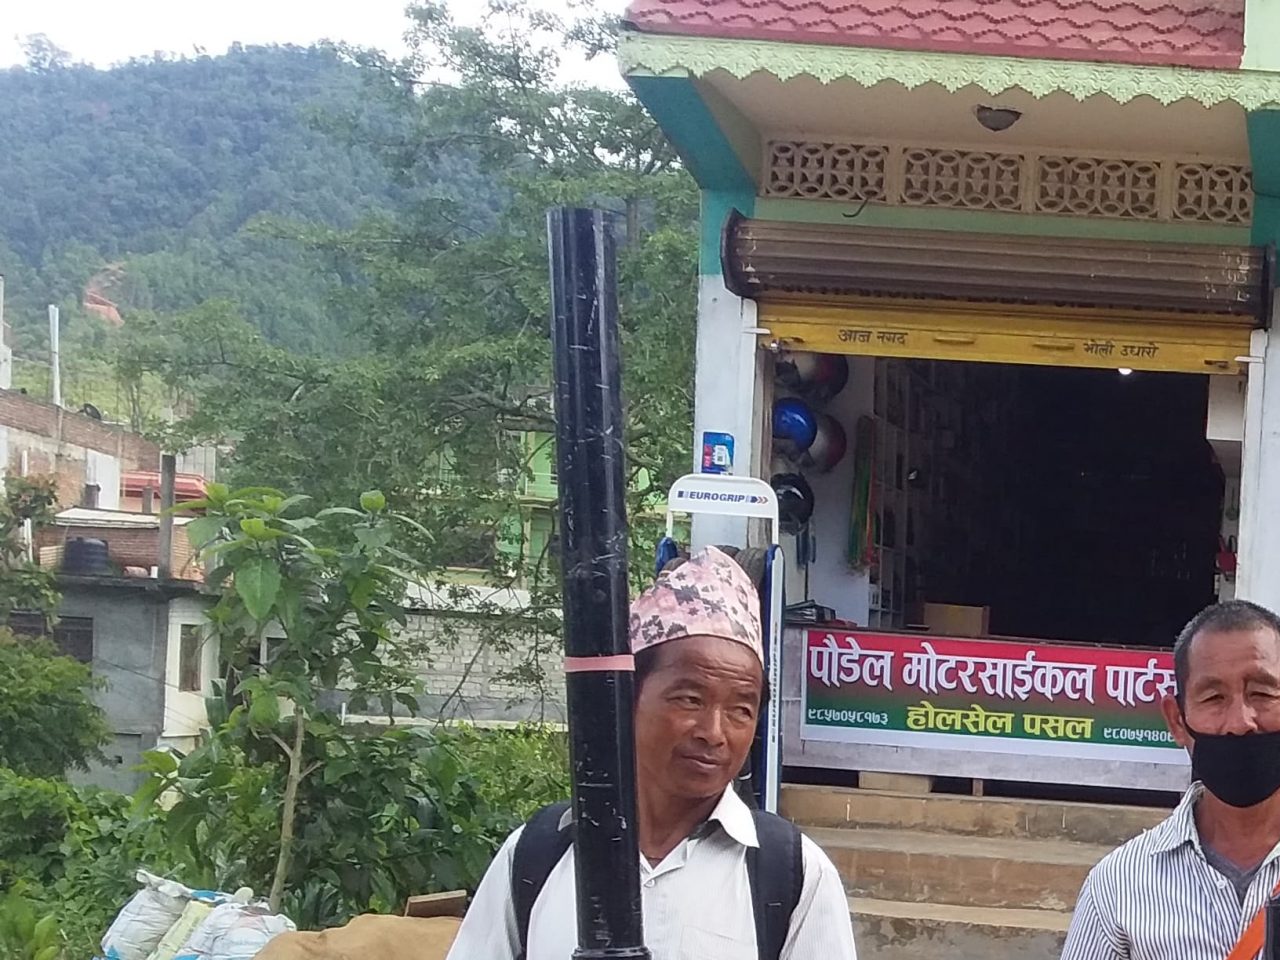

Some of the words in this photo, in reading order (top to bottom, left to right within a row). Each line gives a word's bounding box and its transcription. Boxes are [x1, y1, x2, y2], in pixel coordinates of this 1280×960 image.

[689, 490, 745, 503] EUROGRIP
[809, 634, 895, 692] पौडेल
[903, 641, 1096, 705] मोटरसाईकल
[906, 700, 1013, 735] होलसेल
[1023, 708, 1094, 739] पसल
